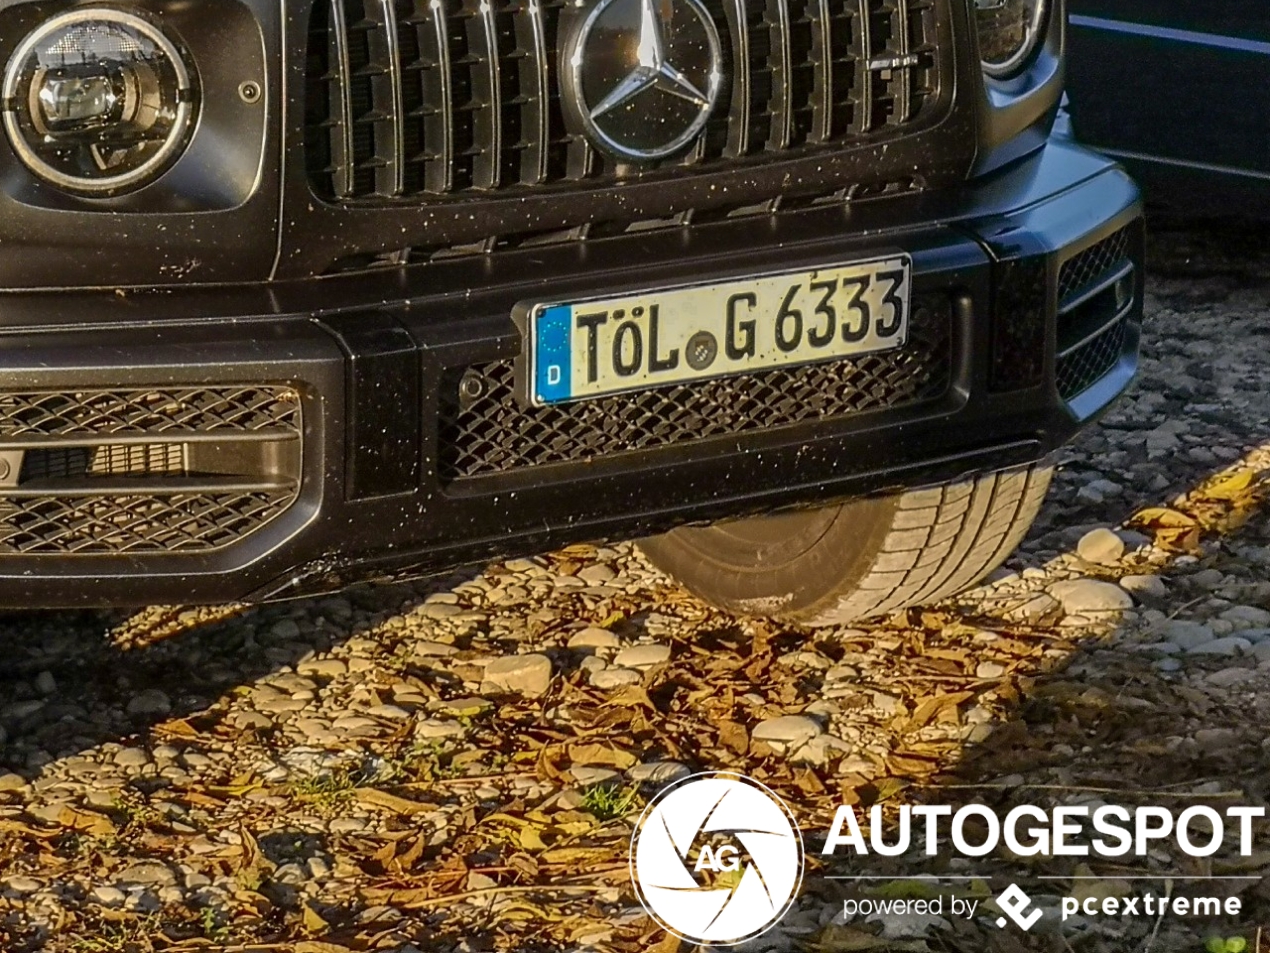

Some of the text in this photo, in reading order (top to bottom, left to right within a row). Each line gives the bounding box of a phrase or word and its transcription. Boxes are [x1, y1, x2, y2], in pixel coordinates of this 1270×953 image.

[576, 269, 904, 384] TÖL G 6333
[547, 364, 561, 385] D
